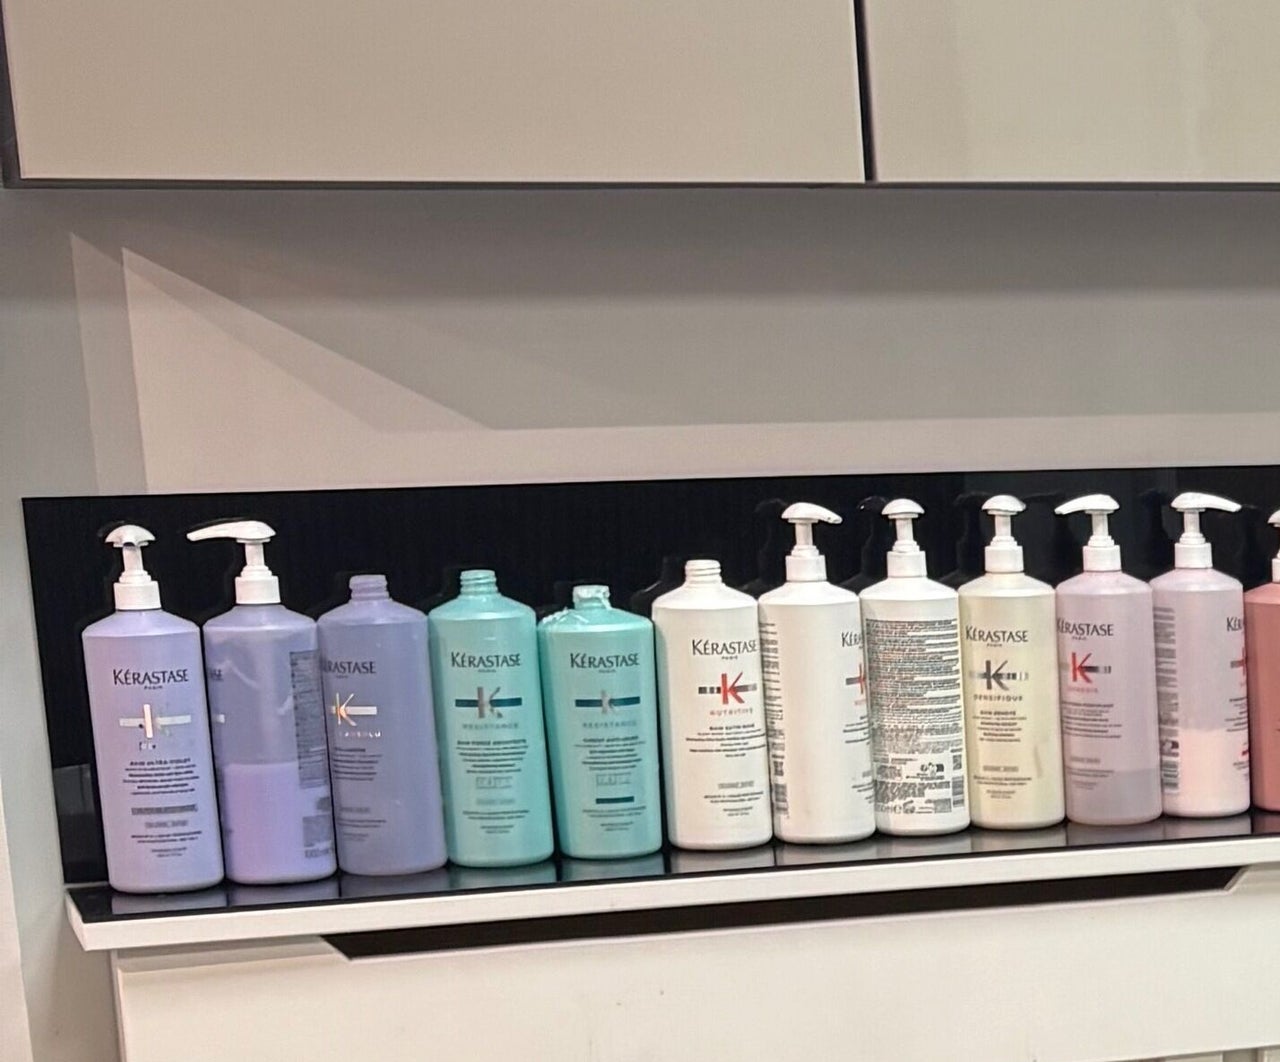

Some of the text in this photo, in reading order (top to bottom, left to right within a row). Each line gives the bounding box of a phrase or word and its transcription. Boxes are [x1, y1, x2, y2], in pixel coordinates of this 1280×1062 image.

[965, 625, 1029, 643] KÉRASTASE
[691, 639, 757, 656] KÉRASTASE
[451, 652, 521, 668] KÉRASTASE
[570, 653, 640, 668] KÉRASTASE
[113, 668, 190, 686] KÉRASTASE
